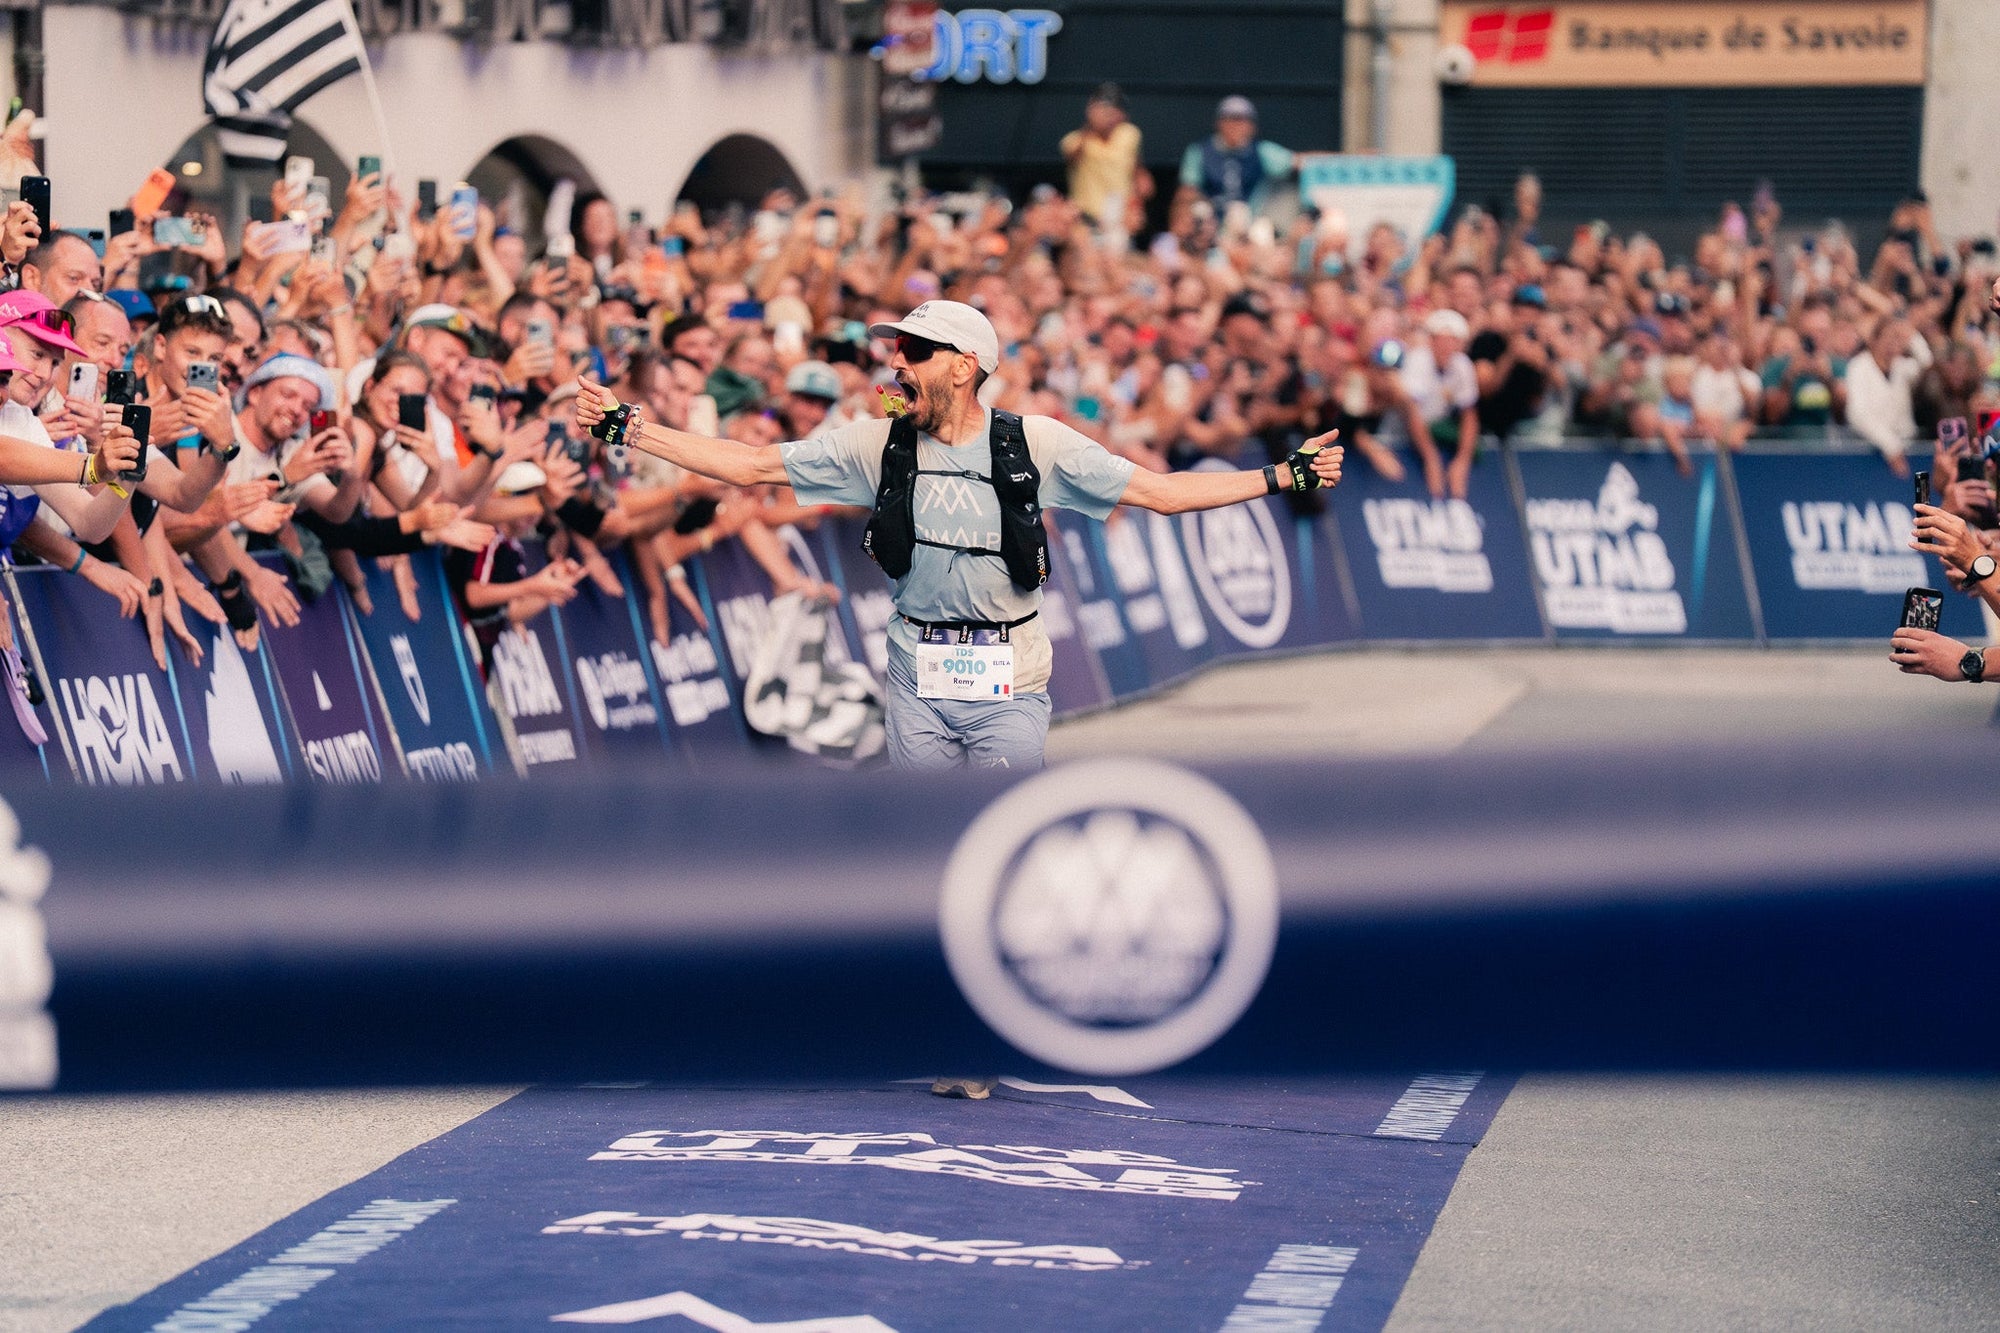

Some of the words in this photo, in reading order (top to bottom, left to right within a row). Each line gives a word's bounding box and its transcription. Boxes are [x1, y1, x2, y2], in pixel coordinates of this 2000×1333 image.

[1568, 18, 1711, 60] Banque
[1722, 16, 1767, 49] de
[1781, 15, 1909, 50] Savoie
[605, 424, 619, 442] EKI
[1362, 498, 1483, 551] UTMB
[1781, 501, 1919, 552] UTMB
[1531, 530, 1676, 588] UTMB
[943, 658, 986, 675] 9010
[955, 648, 975, 657] TDS
[953, 677, 975, 687] Remy
[59, 673, 184, 785] HOKA
[607, 1137, 1244, 1189] UTMB
[553, 1210, 1124, 1264] HOKA
